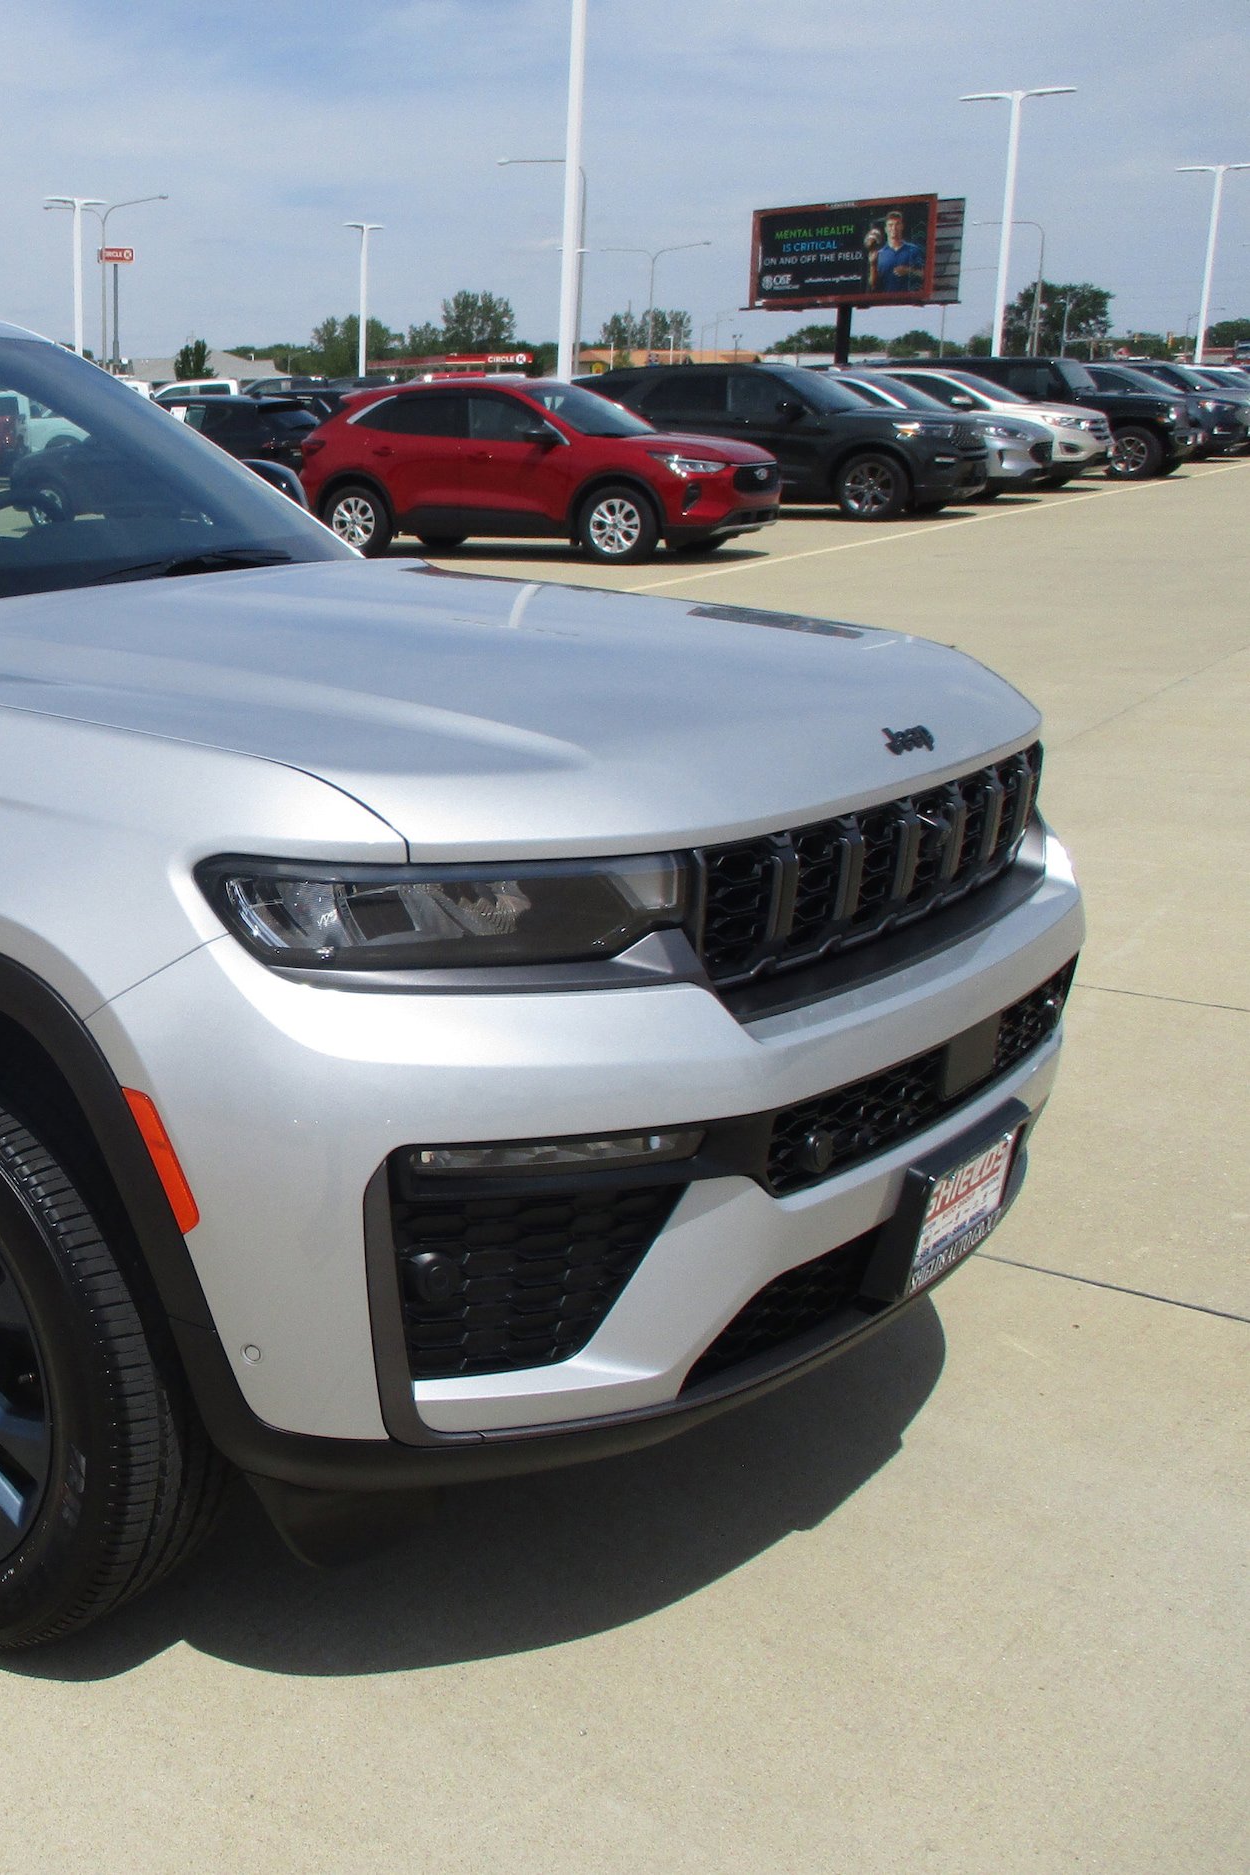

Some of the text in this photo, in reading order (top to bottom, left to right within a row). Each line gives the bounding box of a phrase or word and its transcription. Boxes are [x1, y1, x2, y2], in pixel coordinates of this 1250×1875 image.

[775, 225, 854, 240] MENTAL HEALTH
[782, 240, 838, 253] IS CRITICAL
[763, 250, 864, 267] ON AND OFF THE FIELD.
[488, 355, 515, 364] CIRCLE
